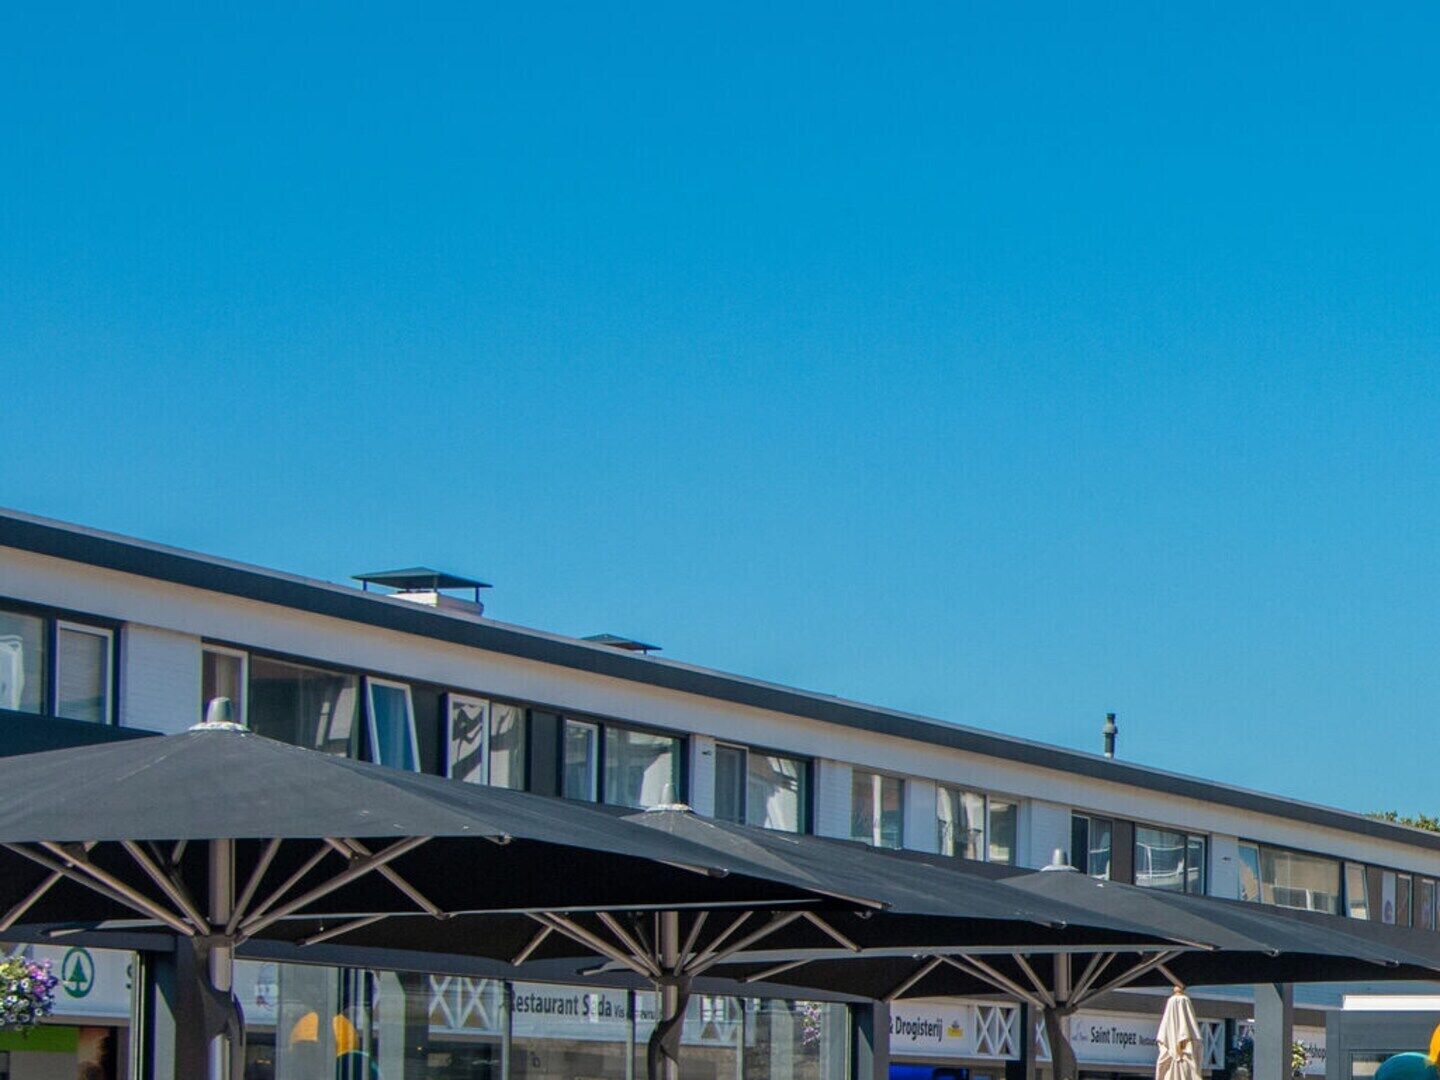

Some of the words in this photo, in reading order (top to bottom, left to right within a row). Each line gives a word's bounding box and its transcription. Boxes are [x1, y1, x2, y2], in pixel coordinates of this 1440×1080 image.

[583, 993, 613, 1018] Sda
[895, 1015, 943, 1042] Drogisterij
[1090, 1026, 1110, 1044] Saint
[1111, 1026, 1137, 1049] Tropez
